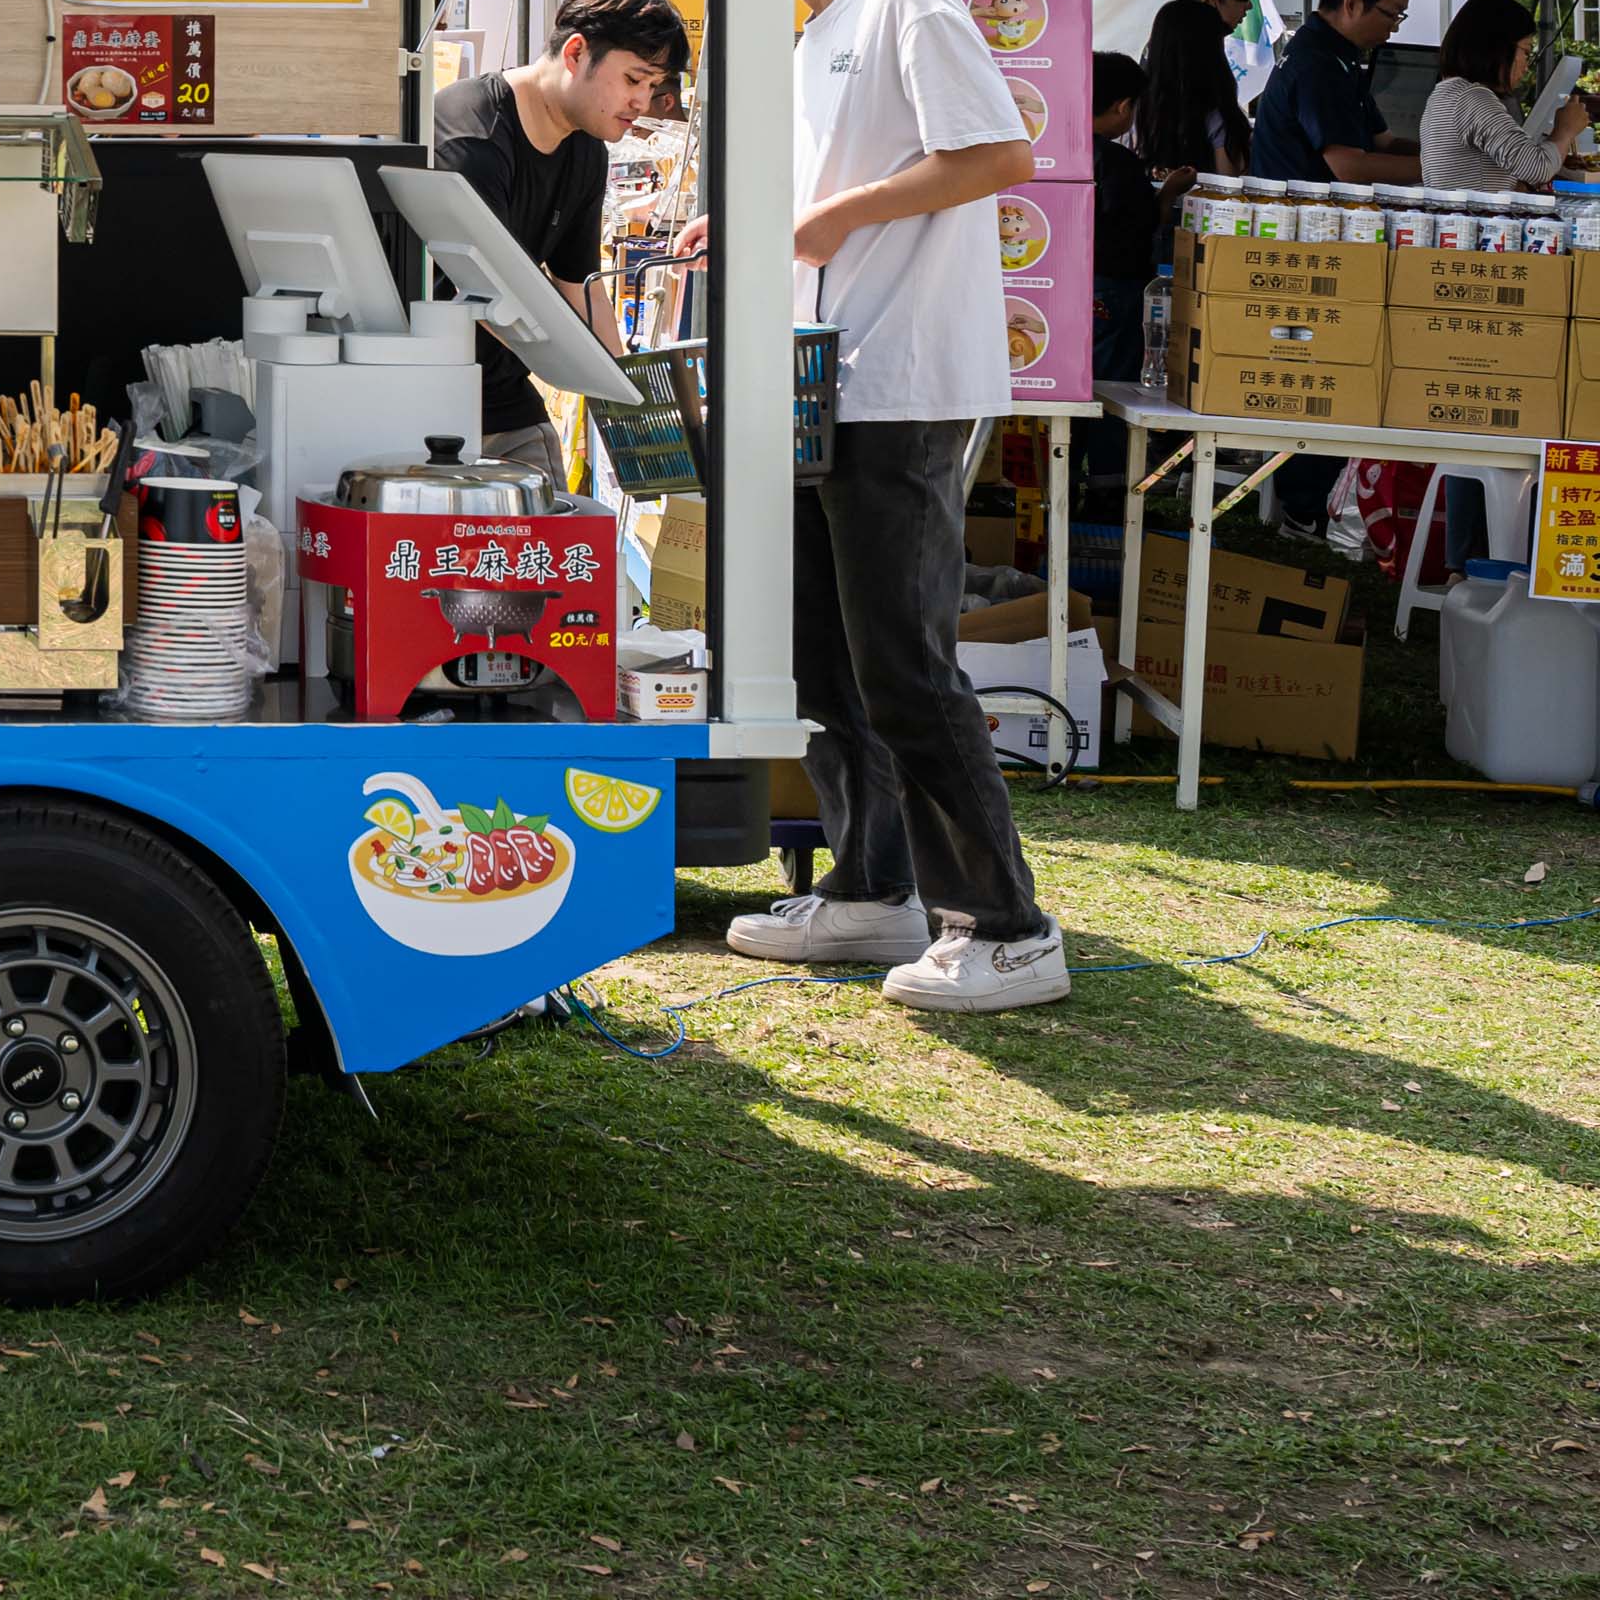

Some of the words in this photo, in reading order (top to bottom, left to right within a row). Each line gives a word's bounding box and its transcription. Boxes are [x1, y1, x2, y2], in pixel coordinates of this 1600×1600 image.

[72, 30, 161, 49] 鼎王麻辣蛋
[185, 21, 202, 79] 推薦價
[177, 83, 210, 103] 20
[1245, 251, 1342, 271] 四季春青茶
[1430, 259, 1528, 281] 古早味紅茶
[1245, 303, 1341, 324] 四季春青茶
[1427, 316, 1524, 337] 古早味紅茶
[1240, 370, 1336, 391] 四季春青茶
[1424, 381, 1522, 403] 古早味紅茶
[385, 540, 600, 585] 鼎王麻辣蛋
[1151, 567, 1253, 605] 古早紅茶
[566, 612, 594, 624] 推薦價
